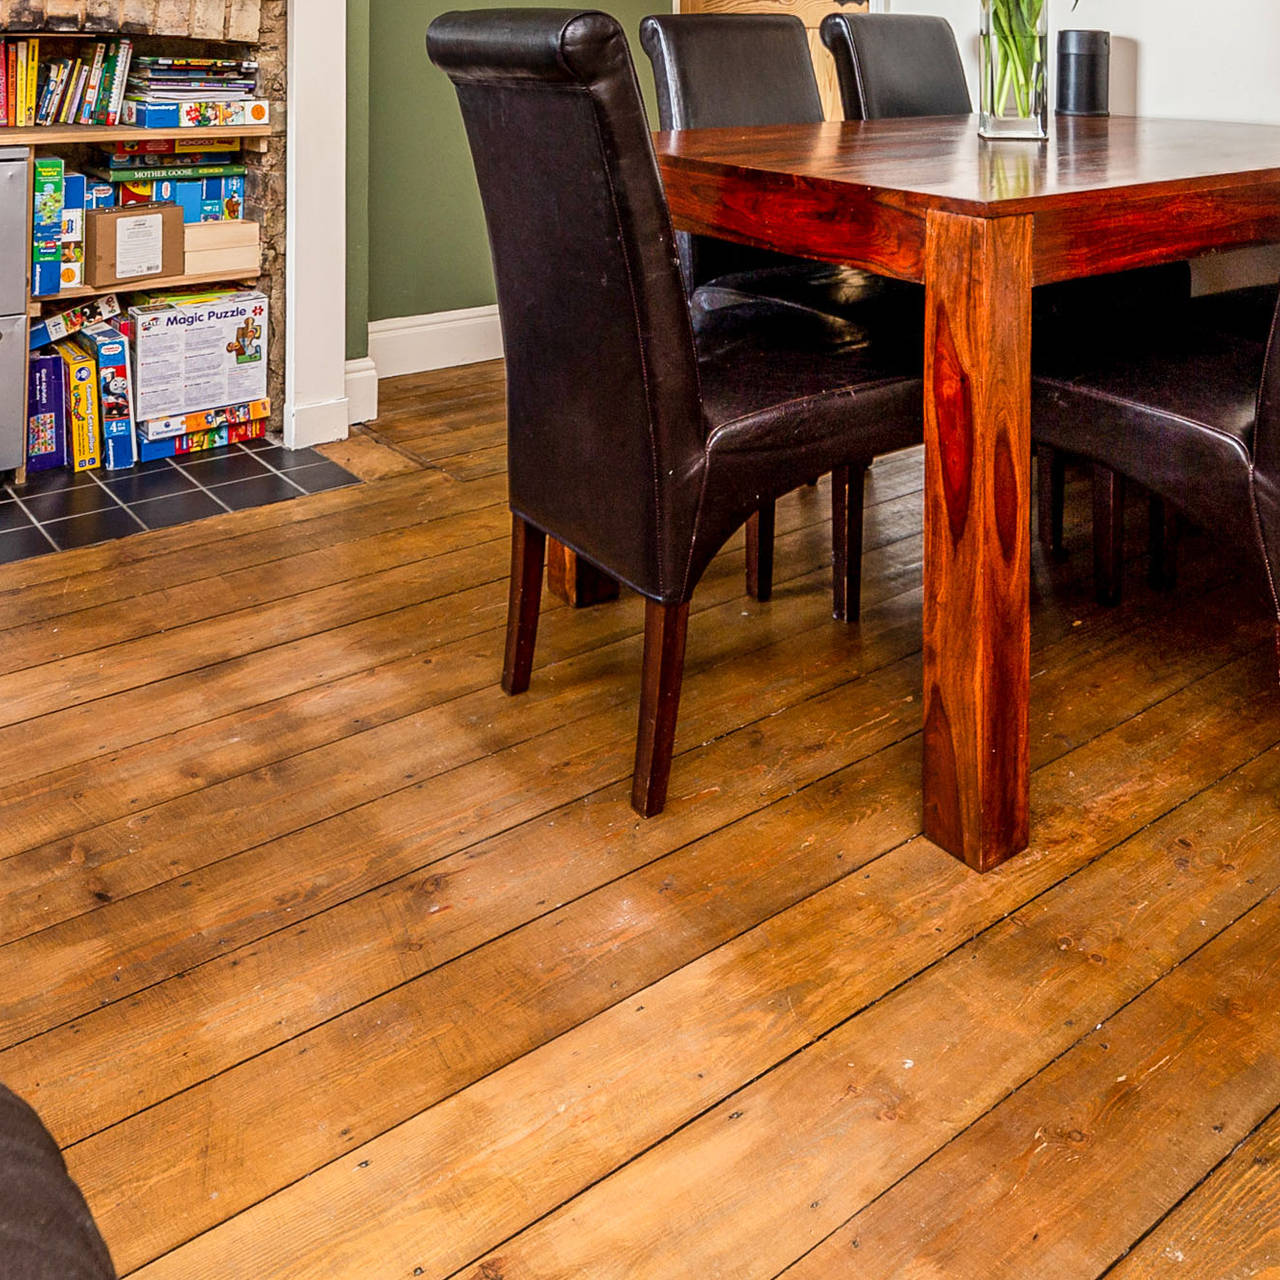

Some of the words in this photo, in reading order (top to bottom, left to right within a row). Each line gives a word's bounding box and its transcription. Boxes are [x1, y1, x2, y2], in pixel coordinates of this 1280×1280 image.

[134, 169, 167, 179] MOTHER
[168, 168, 193, 177] GOOSE
[165, 312, 205, 327] Magic
[207, 306, 247, 321] Puzzle
[141, 319, 159, 327] GALT
